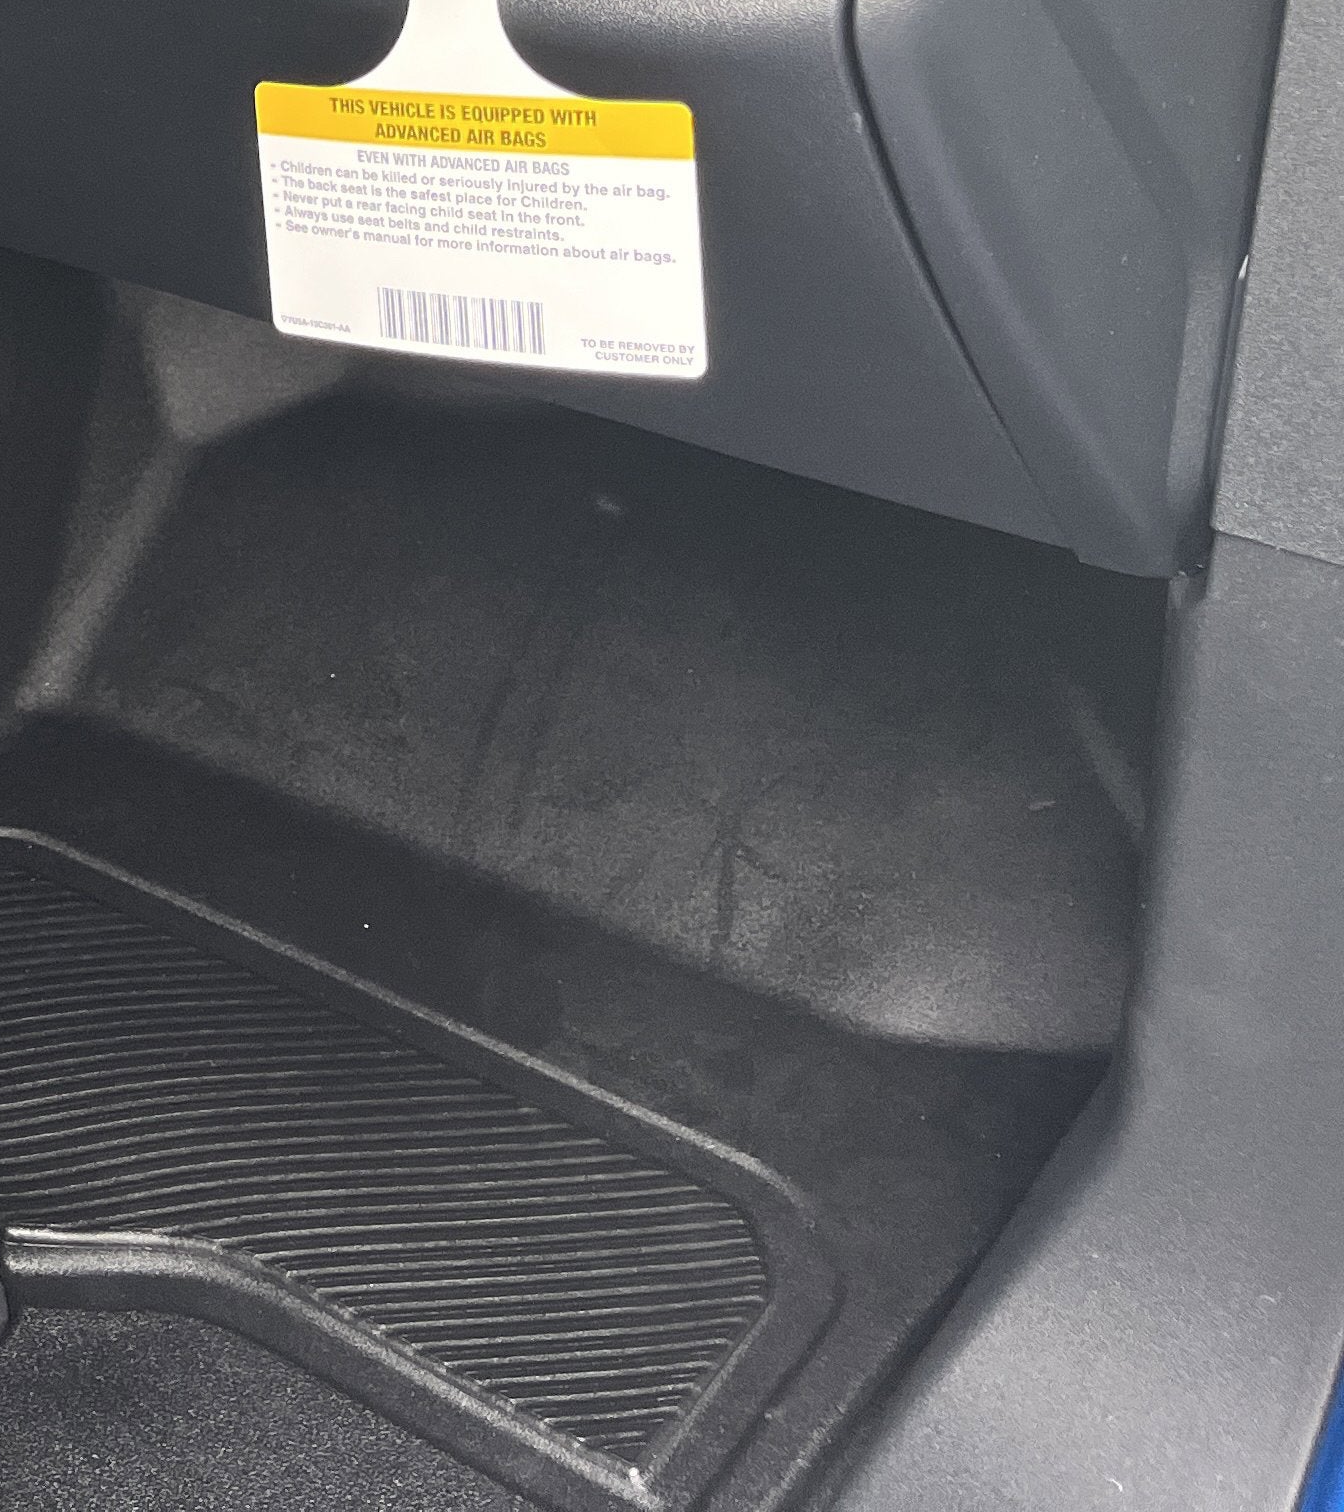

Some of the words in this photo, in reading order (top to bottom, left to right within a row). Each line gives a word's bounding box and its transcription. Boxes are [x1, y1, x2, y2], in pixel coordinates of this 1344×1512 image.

[330, 97, 365, 114] THIS
[369, 100, 436, 119] VEHICLE
[440, 104, 456, 121] IS
[462, 105, 545, 124] EQUIPPED
[550, 108, 597, 127] WITH
[375, 123, 461, 143] ADVANCED
[467, 128, 495, 145] AIR
[500, 131, 547, 148] BAGS
[357, 149, 390, 165] EVEN
[393, 152, 426, 168] WITH
[430, 155, 500, 172] ADVANCED
[505, 159, 528, 174] AIR
[532, 161, 570, 176] BAGS
[280, 160, 332, 177] Children
[335, 167, 359, 180] can
[362, 168, 378, 182] be
[382, 170, 417, 185] killed
[421, 175, 435, 186] or
[439, 175, 503, 194] seriously
[507, 178, 558, 194] injured
[562, 181, 580, 198] by
[584, 183, 608, 197] the
[612, 185, 632, 198] air
[637, 185, 671, 201] bag.
[282, 175, 305, 189] The
[308, 178, 338, 193] back
[341, 183, 368, 196] seat
[371, 185, 382, 197] is
[386, 186, 407, 199] the
[411, 188, 452, 203] safest
[455, 191, 492, 206] place
[497, 193, 517, 207] for
[521, 195, 588, 212] Children.
[283, 190, 319, 206] Never
[322, 196, 343, 211] put
[356, 200, 382, 213] rear
[385, 201, 427, 219] facing
[430, 206, 464, 220] child
[468, 209, 497, 222] seat
[501, 209, 514, 223] in
[518, 211, 542, 225] the
[545, 213, 585, 227] front.
[284, 205, 329, 223] Always
[332, 213, 355, 225] use
[358, 216, 385, 228] seat
[389, 215, 421, 231] belts
[424, 221, 450, 234] and
[453, 222, 487, 236] child
[491, 225, 565, 242] restraints.
[286, 219, 309, 234] See
[312, 225, 360, 240] owner's
[364, 230, 411, 246] manual
[415, 234, 434, 247] for
[437, 238, 472, 251] more
[476, 240, 559, 257] information
[563, 245, 606, 260] about
[610, 248, 629, 262] air
[634, 249, 677, 265] bags.
[581, 338, 596, 348] TO
[600, 339, 615, 350] BE
[618, 341, 676, 354] REMOVED
[679, 345, 695, 355] BY
[595, 351, 660, 364] CUSTOMER
[663, 355, 694, 366] ONLY
